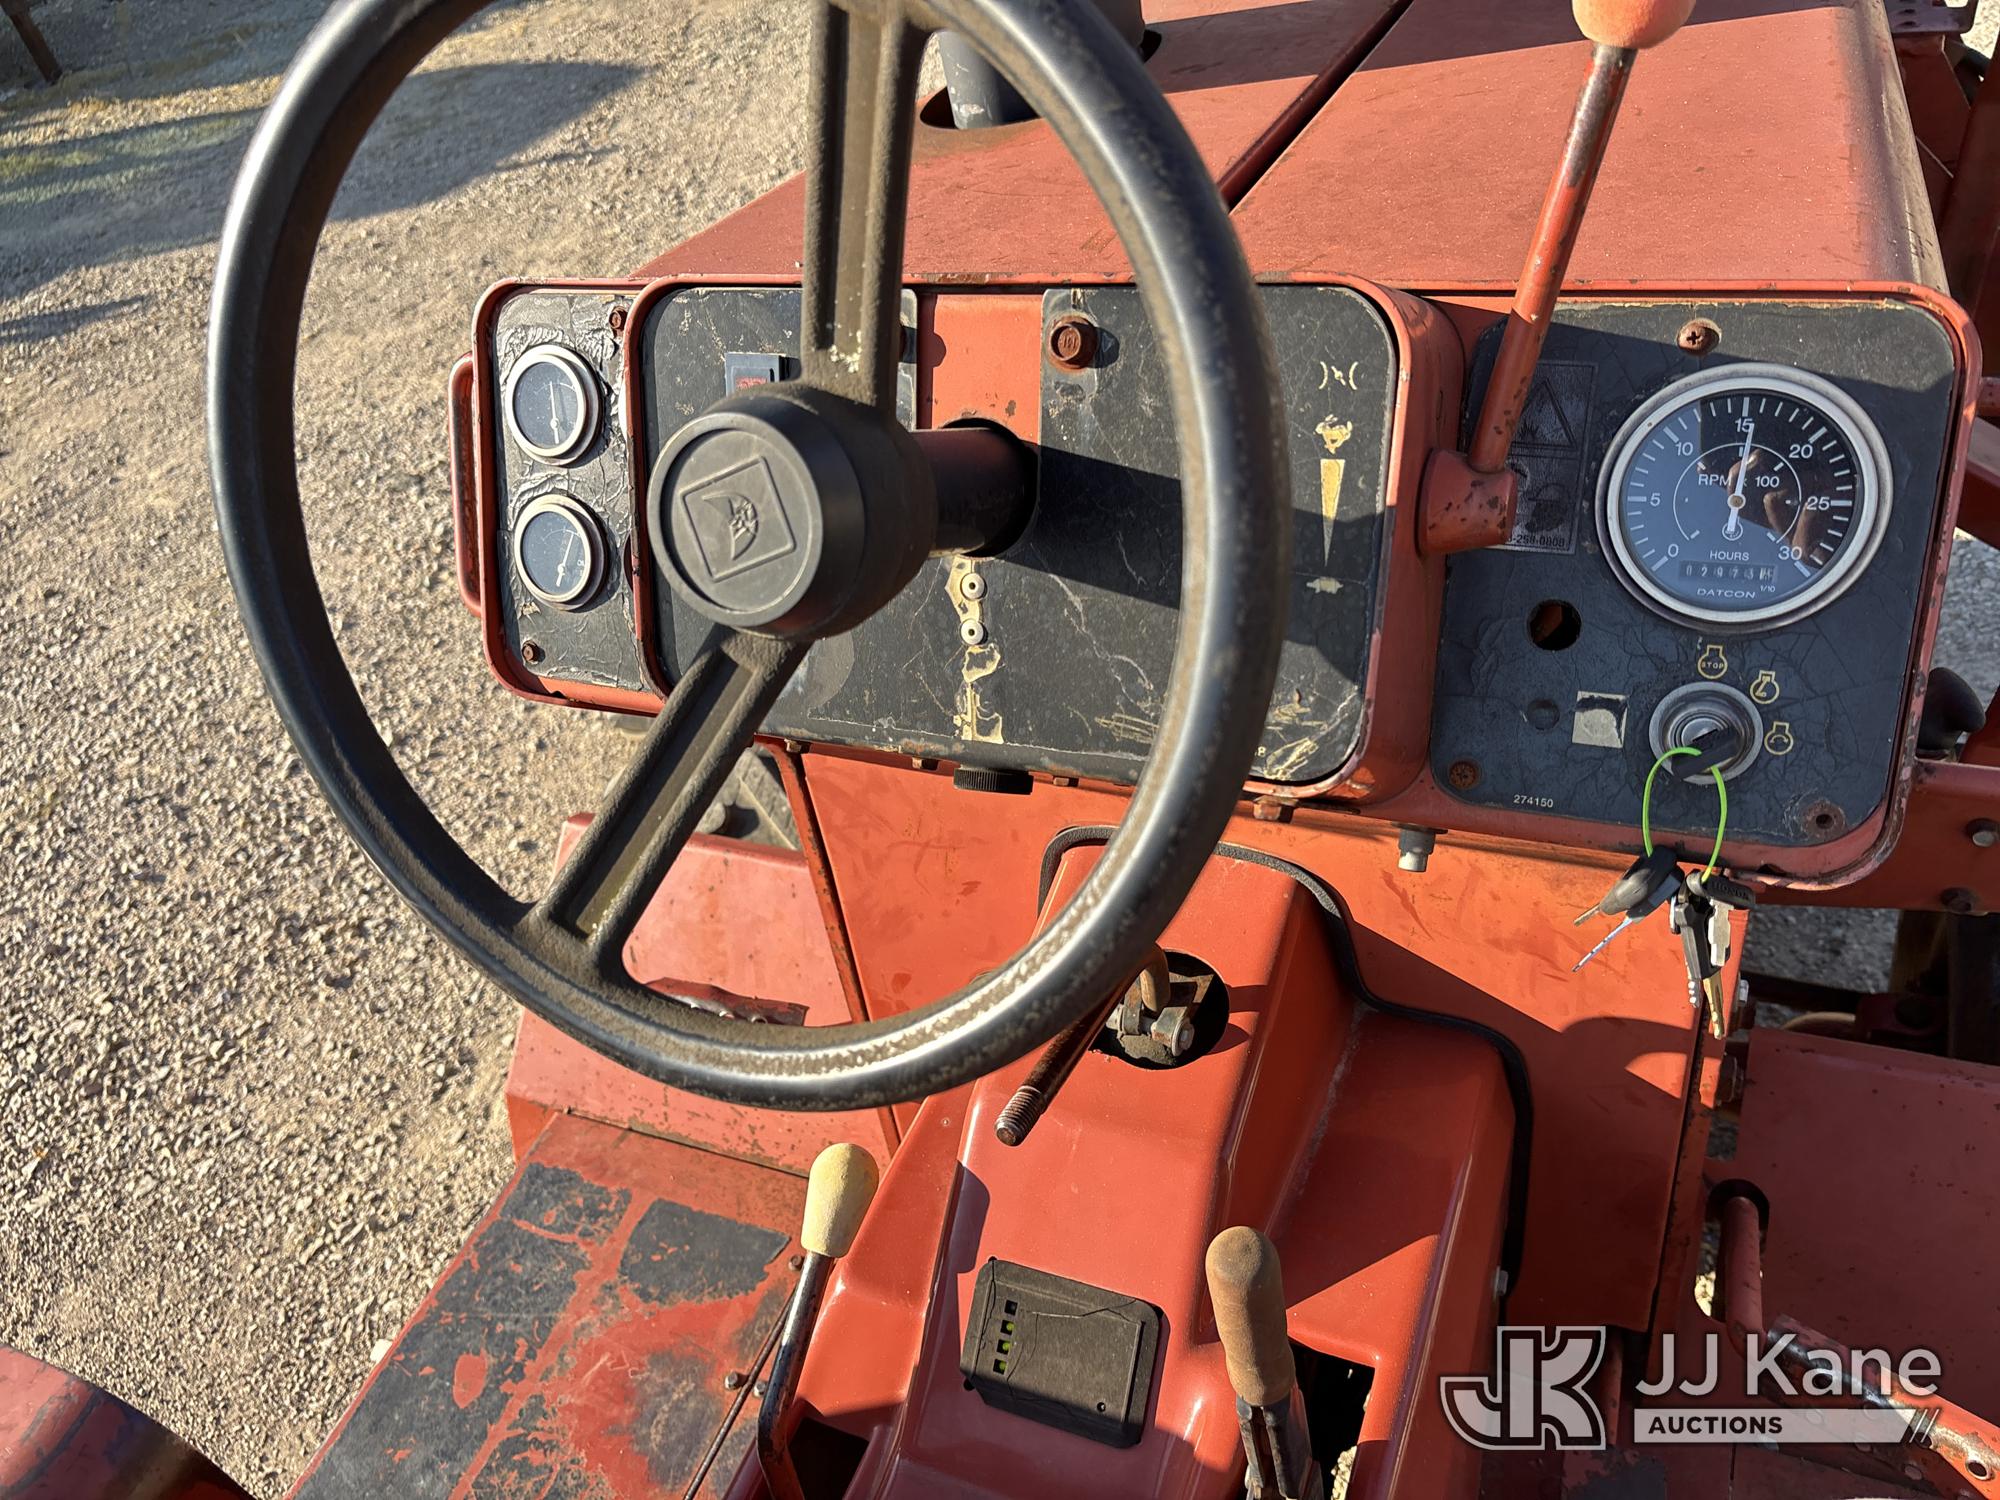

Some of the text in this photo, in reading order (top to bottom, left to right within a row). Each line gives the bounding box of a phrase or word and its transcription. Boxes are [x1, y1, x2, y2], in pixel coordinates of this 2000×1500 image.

[1735, 418, 1753, 433] 15
[1675, 442, 1694, 456] 10
[1788, 443, 1813, 459] 20
[1698, 474, 1732, 487] RPM
[1755, 475, 1780, 488] 100
[1650, 493, 1661, 507] 5
[1806, 496, 1830, 511] 25
[1667, 543, 1679, 558] 0
[1709, 550, 1750, 561] HOURS
[1778, 545, 1802, 560] 30
[1696, 588, 1756, 599] DATCON
[1760, 585, 1776, 593] 1/10
[1701, 661, 1724, 669] STOP
[1513, 794, 1554, 808] 274150
